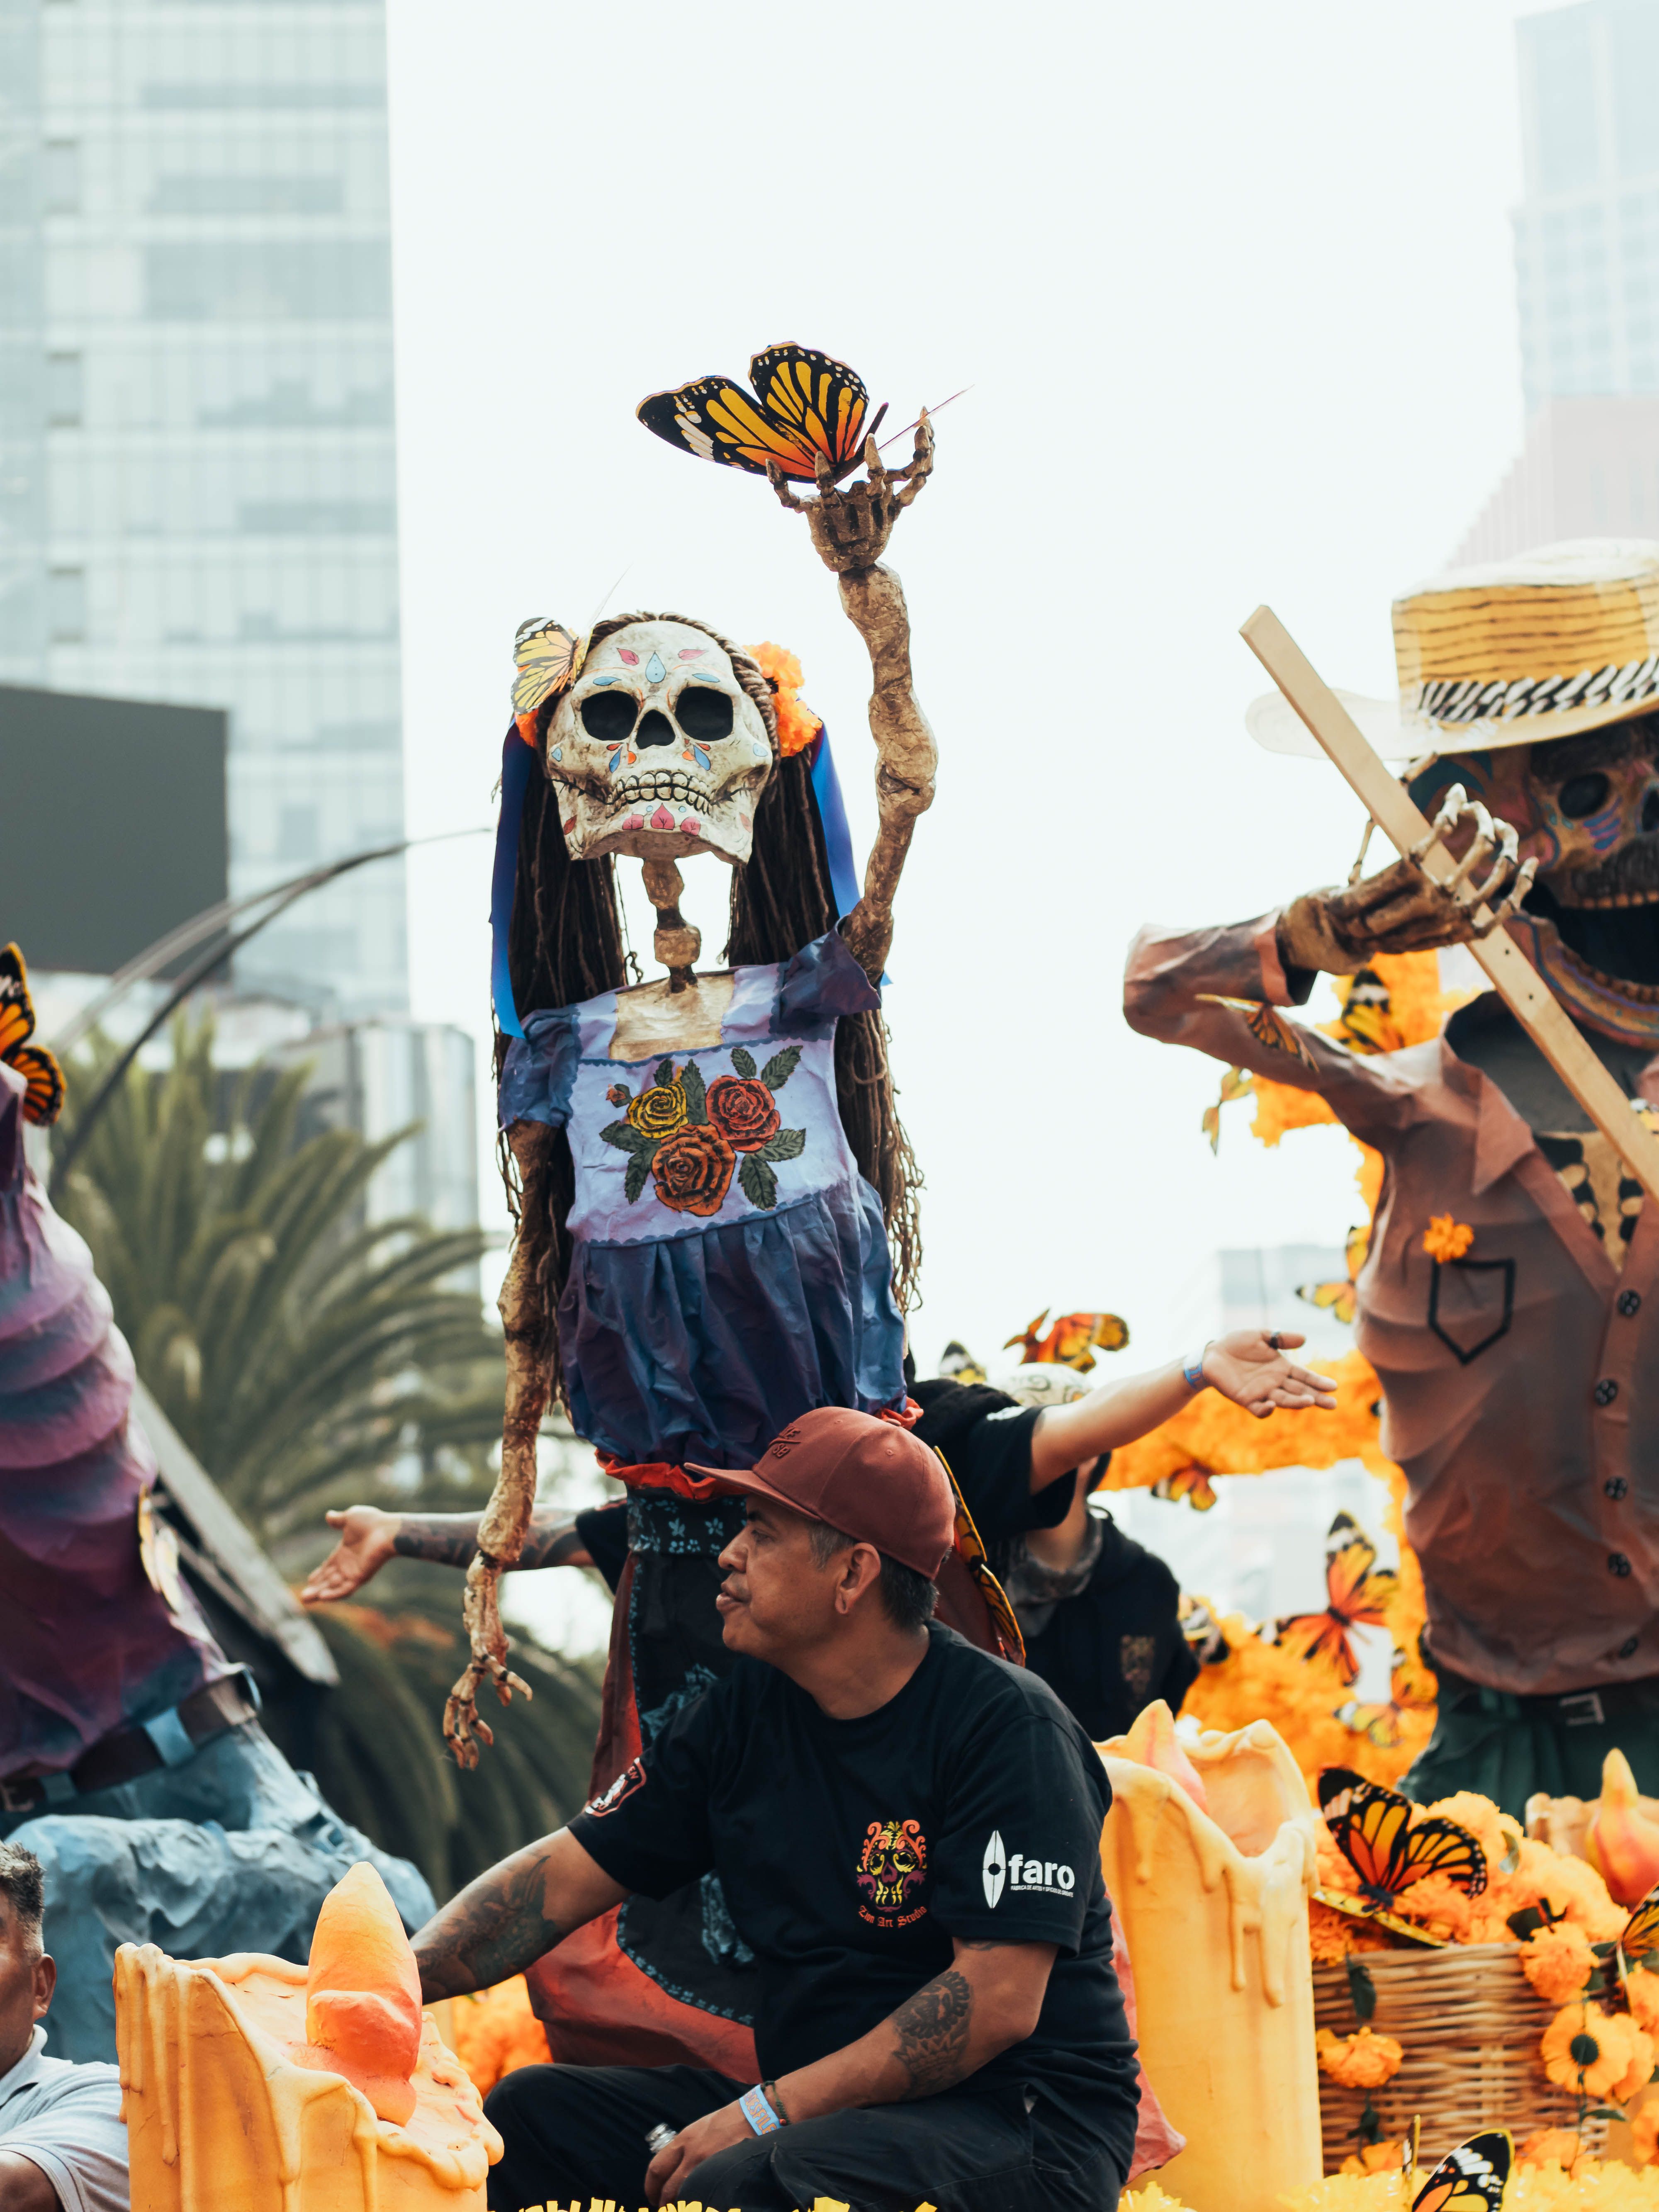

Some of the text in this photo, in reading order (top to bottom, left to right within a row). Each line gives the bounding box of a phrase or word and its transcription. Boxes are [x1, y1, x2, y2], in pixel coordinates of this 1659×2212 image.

[1008, 1854, 1075, 1890] faro
[859, 1905, 927, 1928] Zion Art Studio
